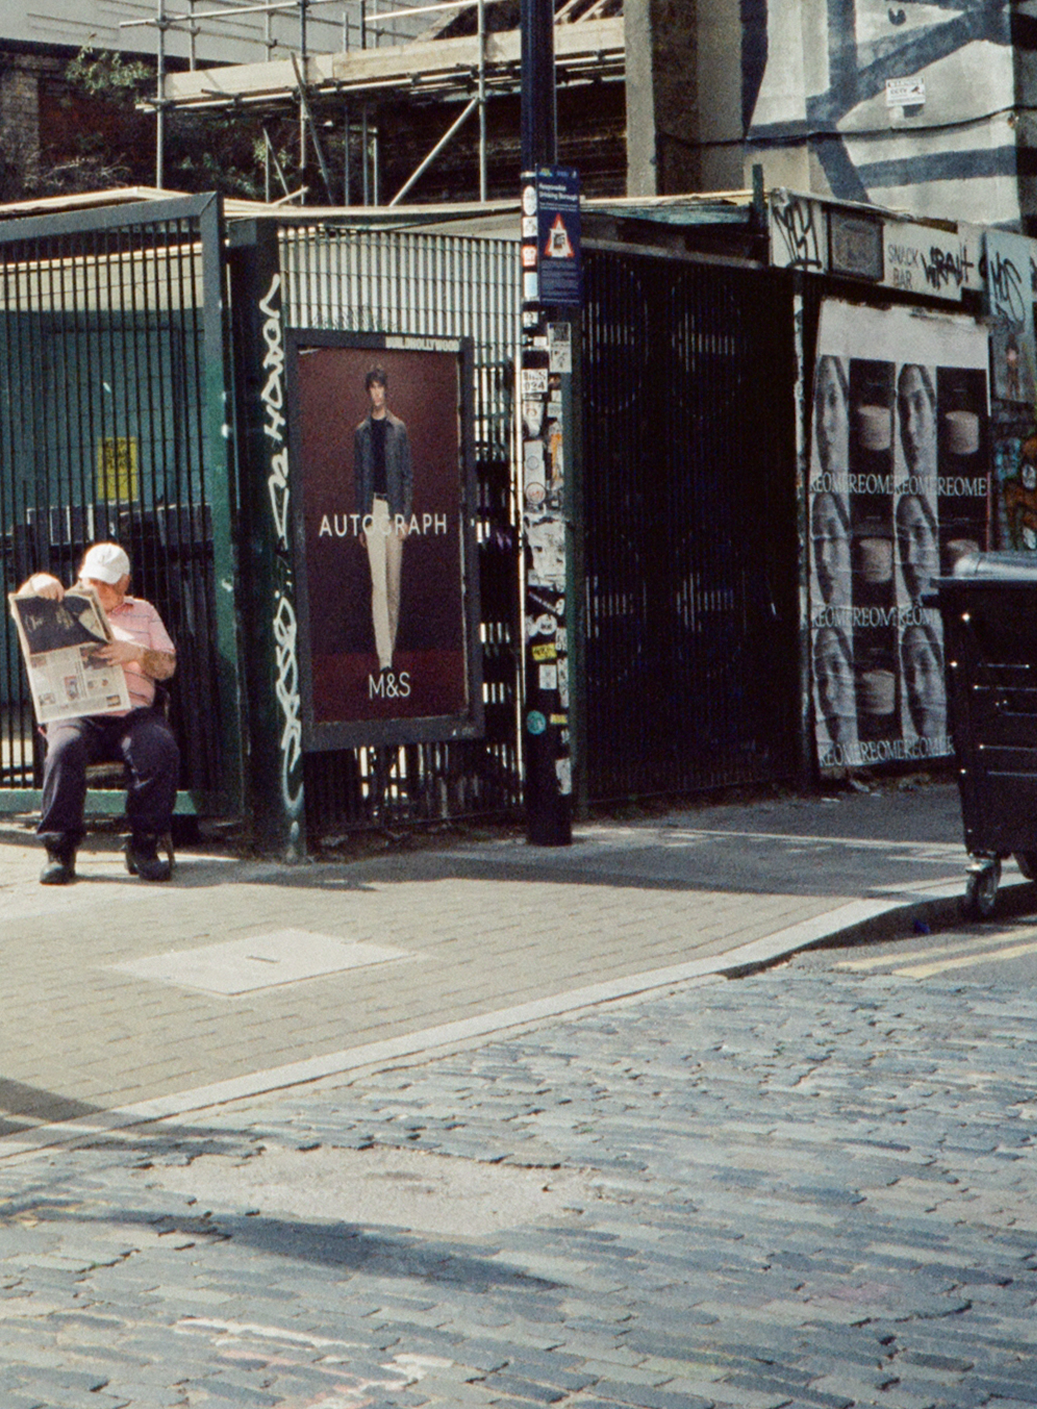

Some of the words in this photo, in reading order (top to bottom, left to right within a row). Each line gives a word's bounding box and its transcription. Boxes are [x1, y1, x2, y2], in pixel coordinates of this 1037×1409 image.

[893, 267, 912, 290] BAR
[937, 475, 987, 497] REOME
[318, 513, 447, 537] AUTOGRAPH
[368, 672, 411, 699] M&S
